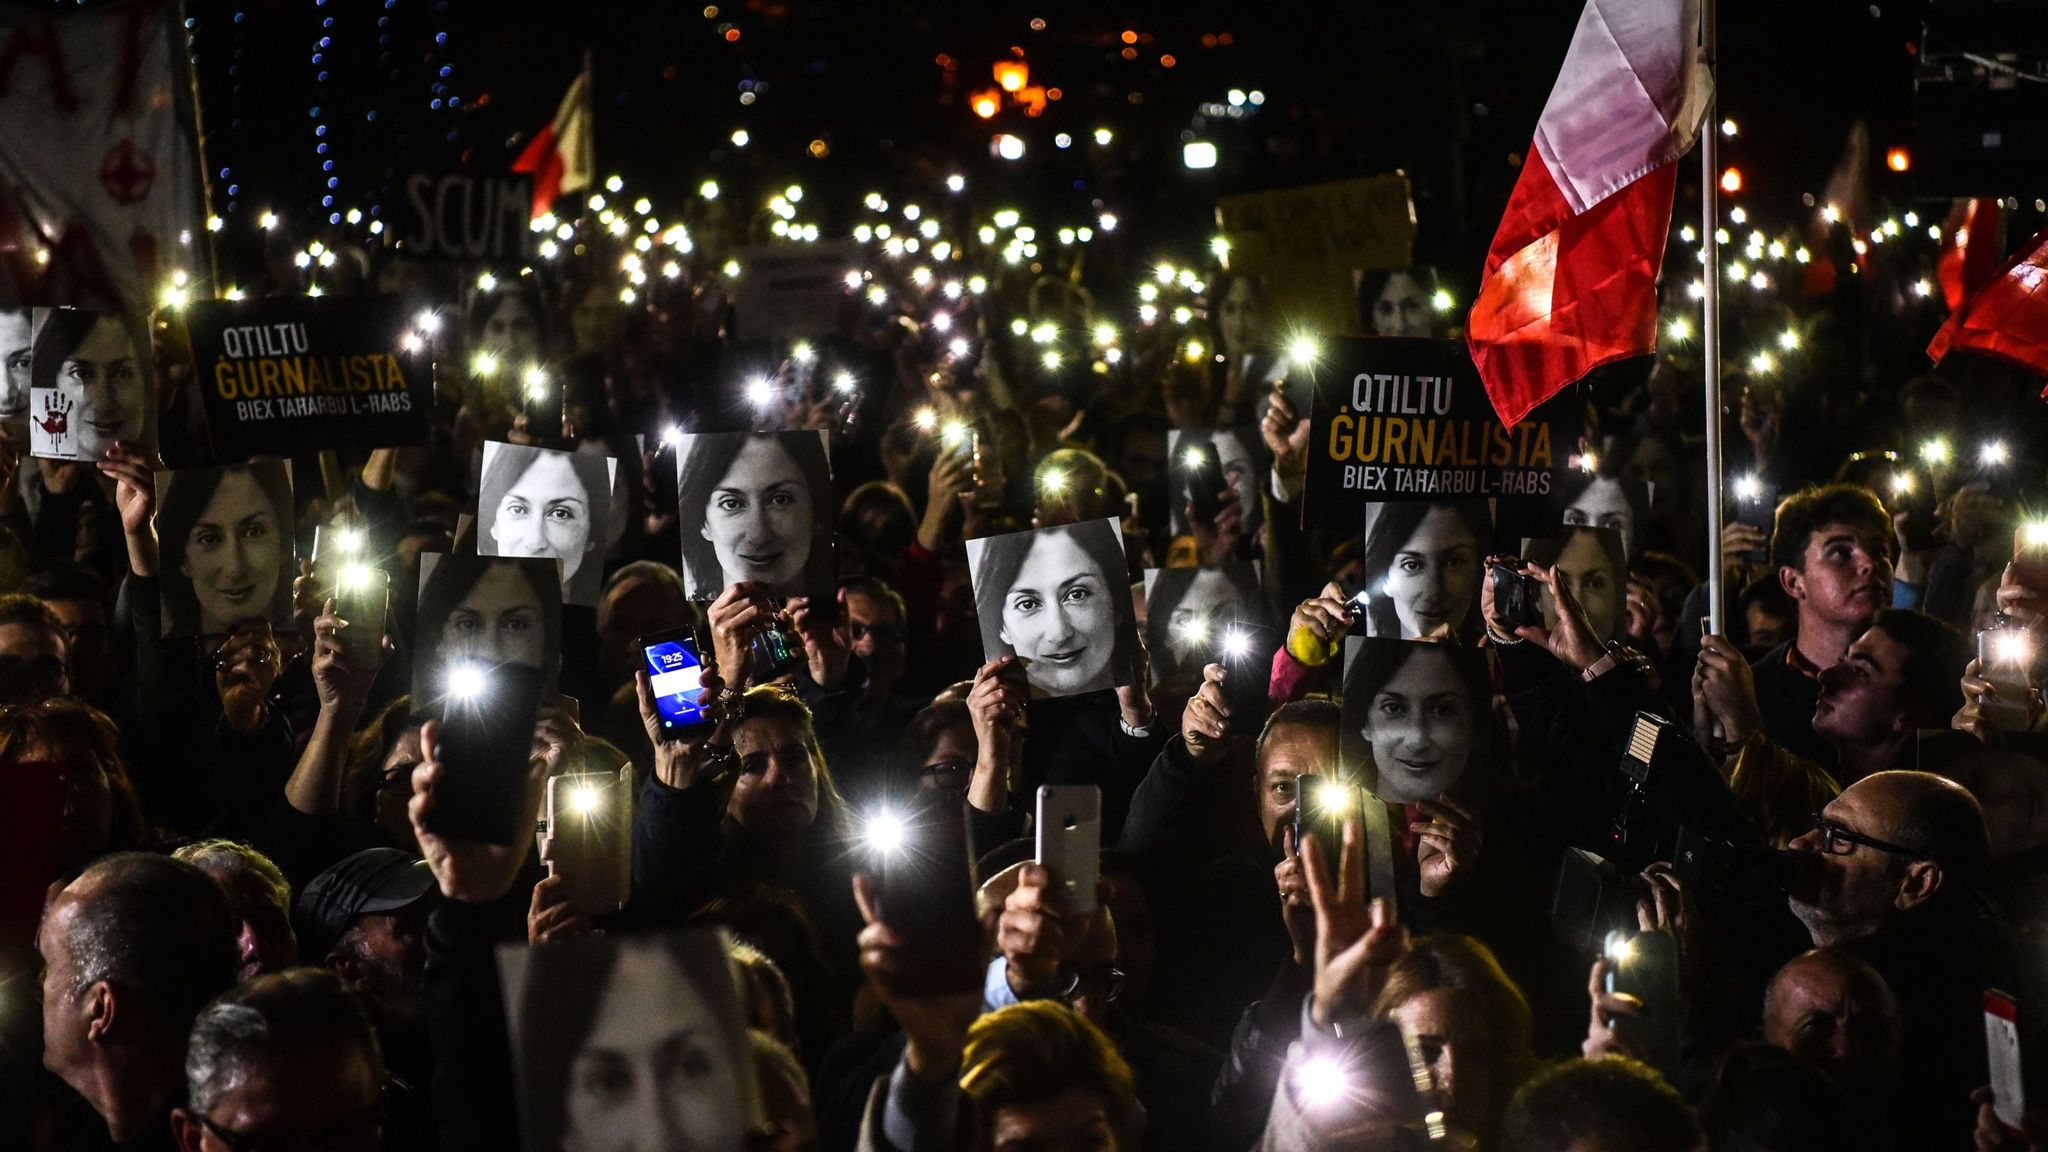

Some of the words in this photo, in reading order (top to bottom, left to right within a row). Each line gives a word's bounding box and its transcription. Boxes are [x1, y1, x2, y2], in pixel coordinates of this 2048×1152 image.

[406, 172, 529, 257] SCUM
[222, 321, 309, 358] QTILTU
[214, 354, 406, 400] ĠURNALISTA
[1351, 373, 1453, 416] QTILTU
[236, 399, 275, 421] BIEX
[1328, 405, 1553, 468] ĠURNALISTA
[1343, 464, 1387, 491] BIEX
